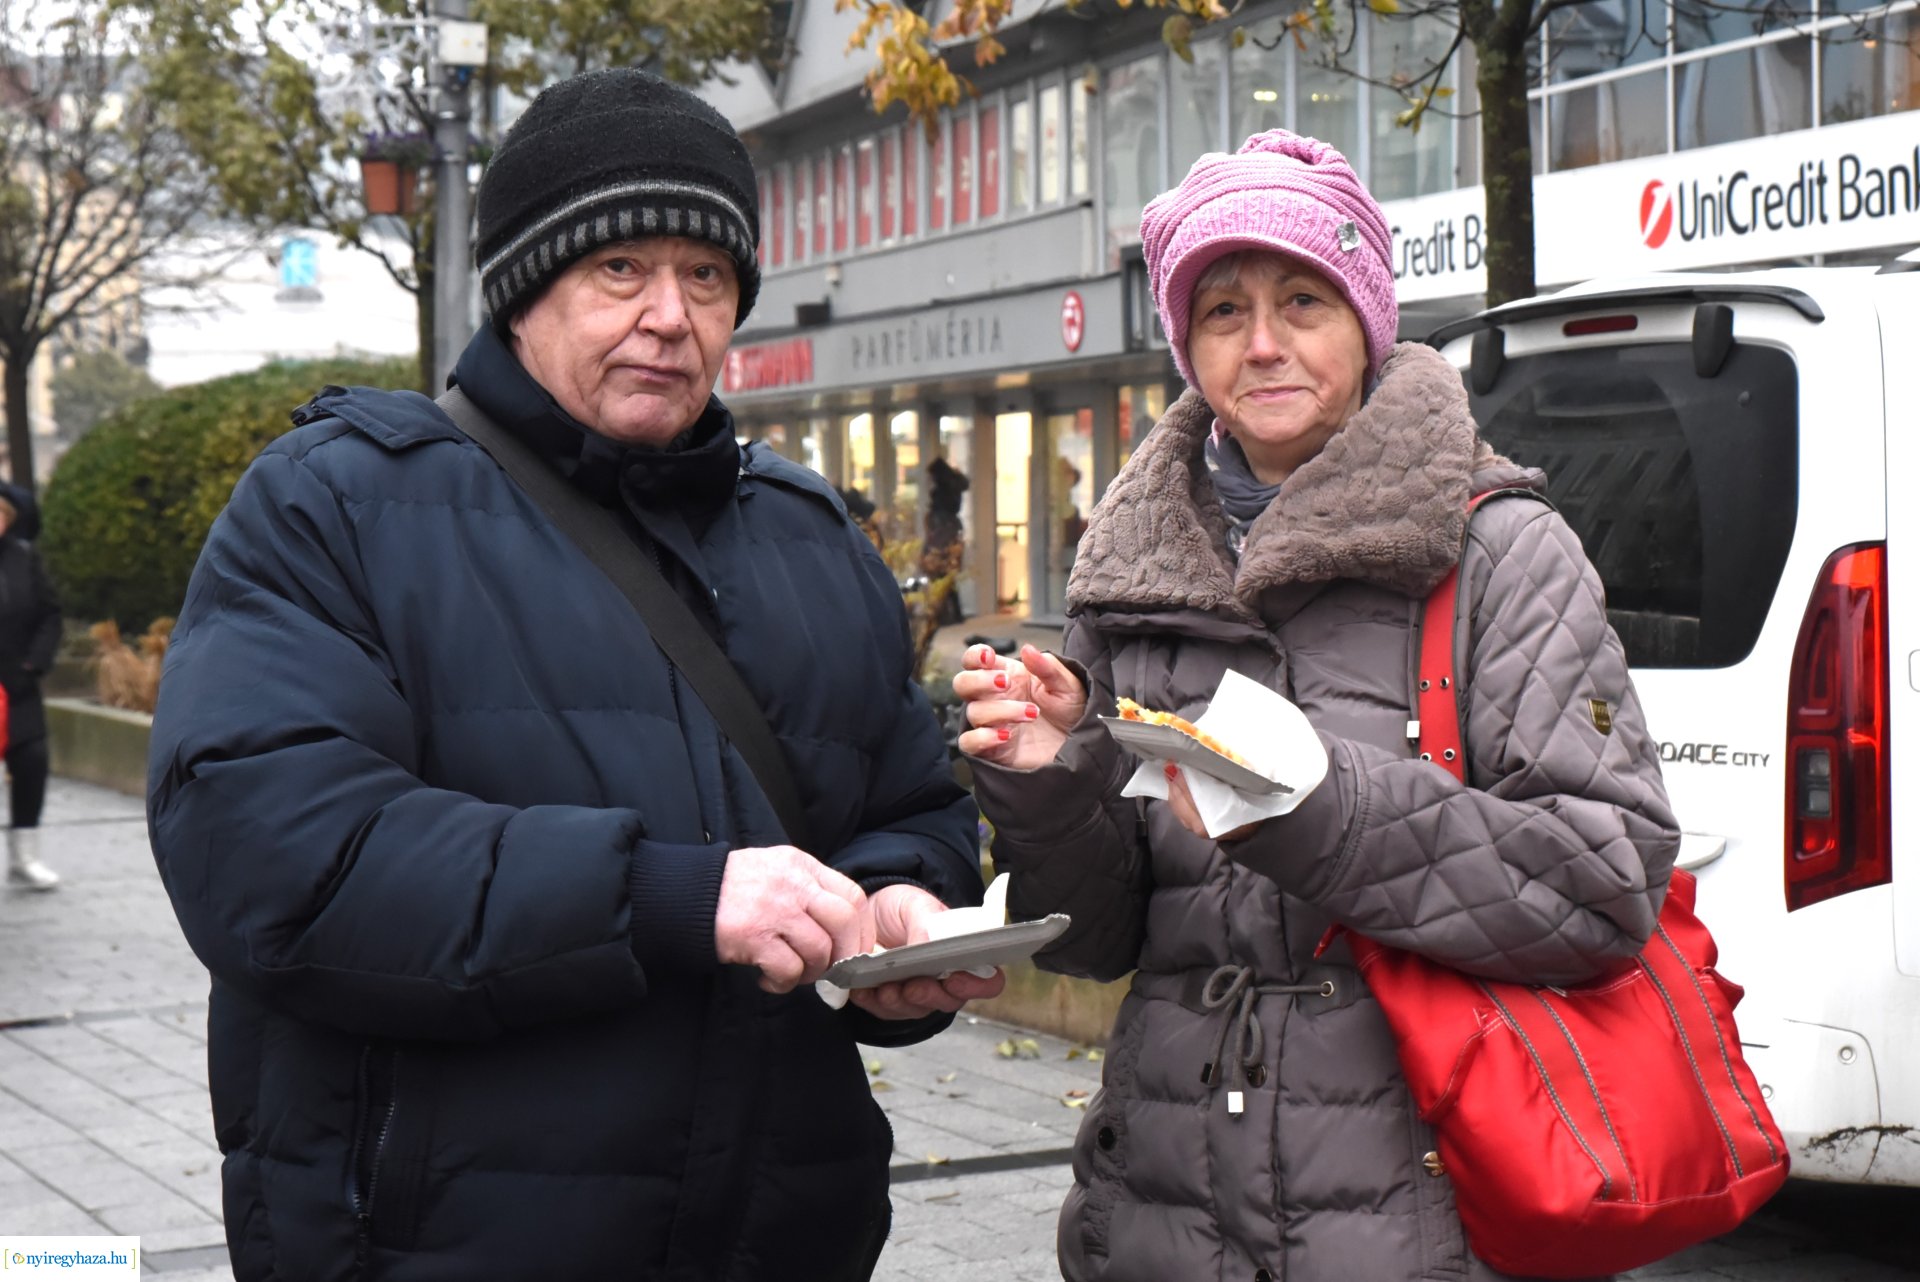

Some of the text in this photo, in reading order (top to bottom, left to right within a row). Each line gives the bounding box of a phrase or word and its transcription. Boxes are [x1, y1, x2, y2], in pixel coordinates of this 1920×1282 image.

[1678, 159, 1829, 242] UniCredit
[1464, 213, 1487, 270] B
[1654, 741, 1770, 768] OACE CITY
